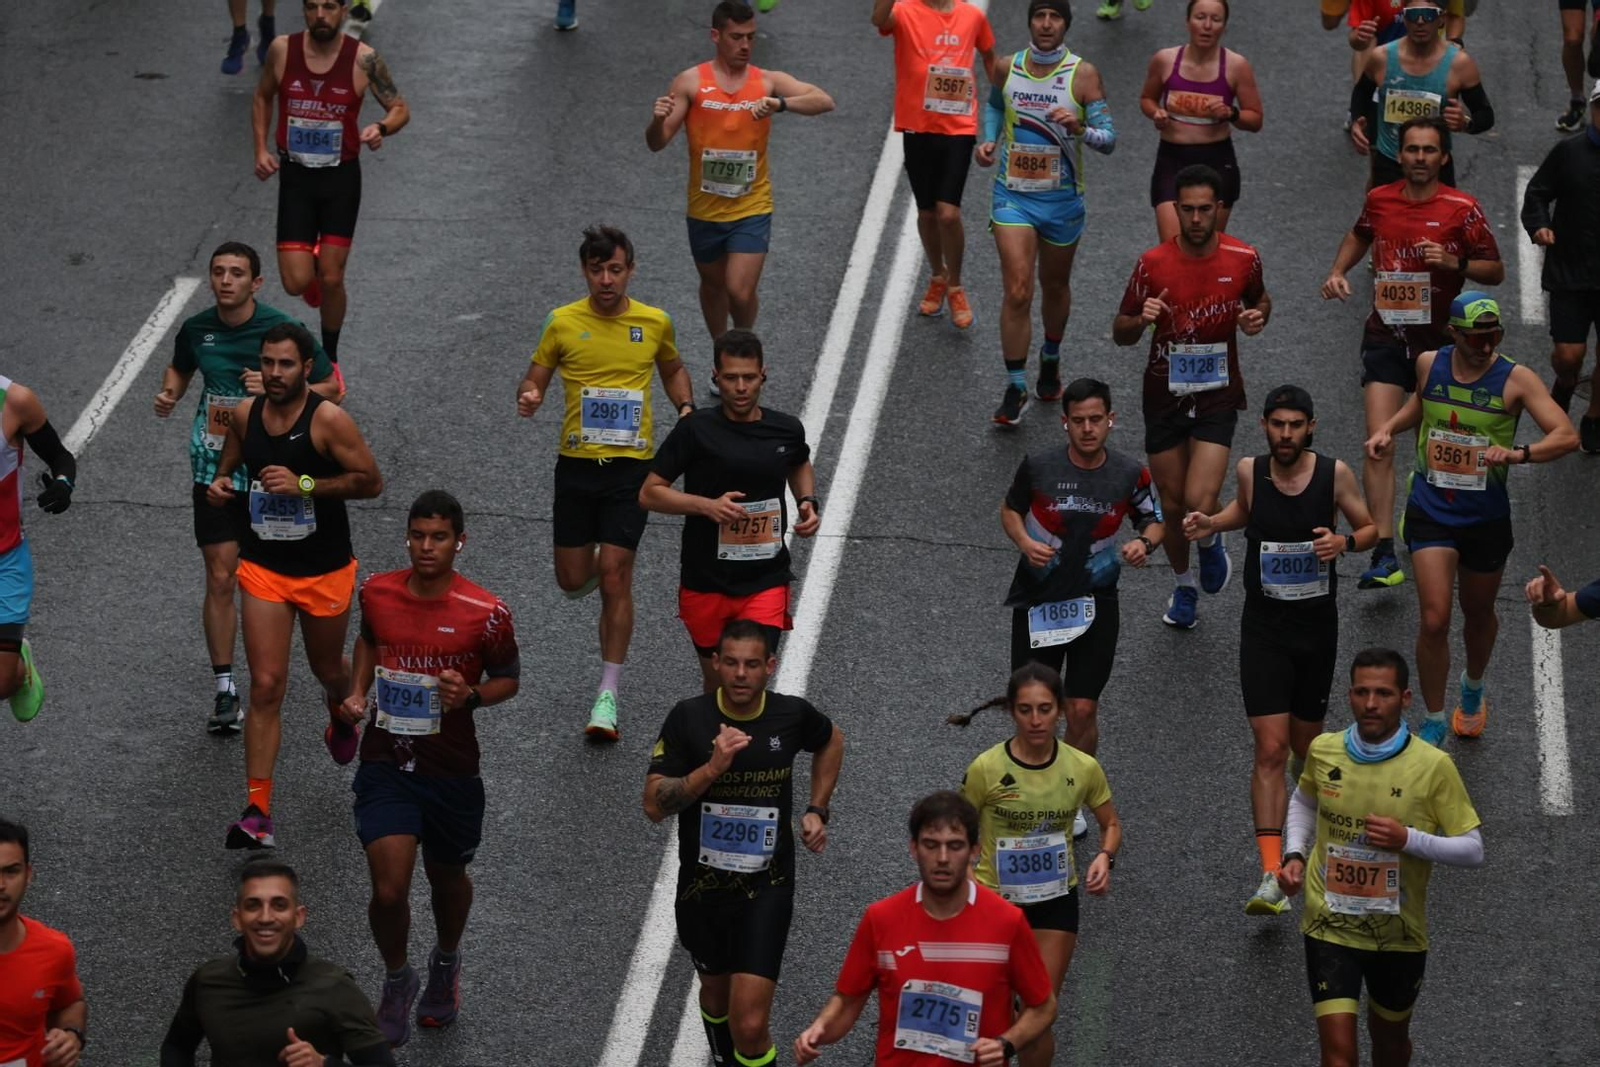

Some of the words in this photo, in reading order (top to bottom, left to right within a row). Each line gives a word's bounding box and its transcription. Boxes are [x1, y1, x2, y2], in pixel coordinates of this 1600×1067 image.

[935, 30, 959, 46] ria
[934, 77, 965, 93] 3567
[1012, 92, 1058, 104] FONTANA
[1390, 100, 1431, 116] 14386
[295, 130, 330, 146] 3164
[710, 161, 743, 177] 7797
[1014, 155, 1047, 171] 4884
[1381, 285, 1416, 301] 4033
[1178, 357, 1215, 374] 3128
[213, 409, 232, 428] 48
[590, 402, 628, 420] 2981
[1434, 445, 1471, 466] 3561
[258, 497, 299, 516] 2453
[730, 515, 768, 535] 4757
[1271, 557, 1315, 575] 2802
[1039, 602, 1079, 622] 1869
[383, 684, 424, 708] 2794
[994, 806, 1035, 822] AMIGOS
[711, 820, 759, 843] 2296
[1007, 852, 1053, 873] 3388
[1334, 863, 1381, 886] 5307
[911, 997, 961, 1027] 2775
